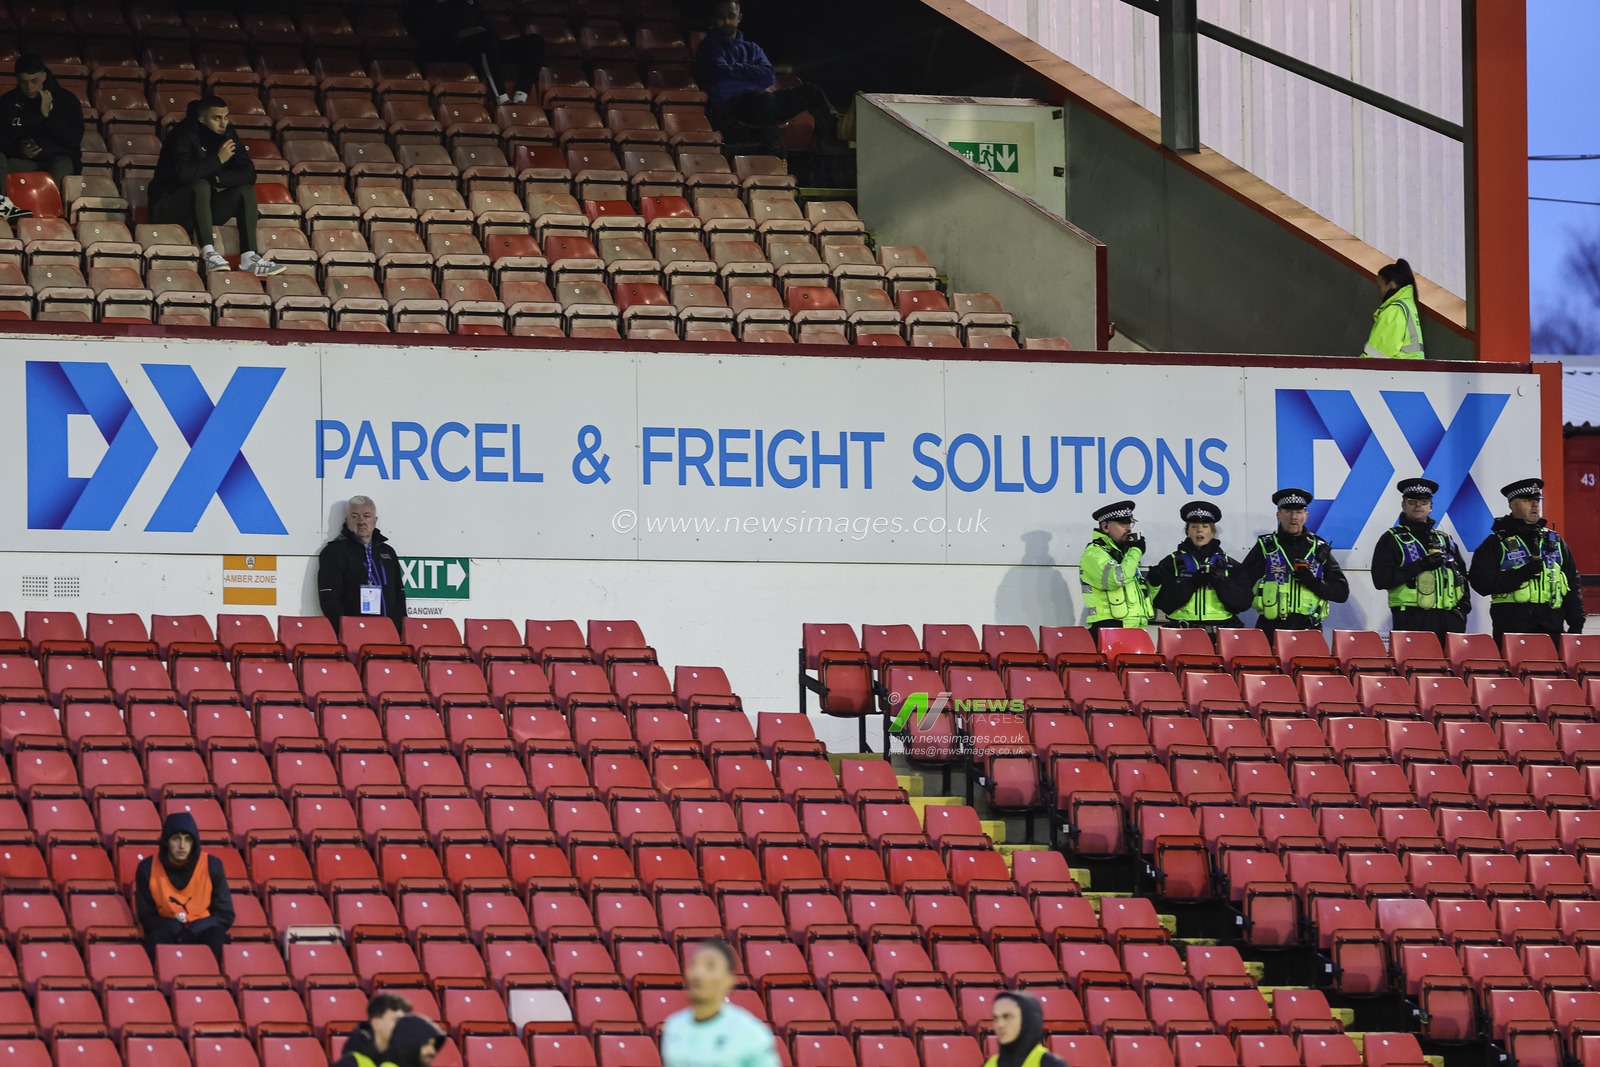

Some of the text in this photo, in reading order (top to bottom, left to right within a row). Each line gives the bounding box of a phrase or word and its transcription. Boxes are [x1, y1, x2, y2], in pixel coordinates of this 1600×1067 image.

[26, 361, 288, 535] DX
[316, 420, 1231, 496] PARCEL & FREIGHT SOLUTIONS
[1275, 389, 1511, 552] DX
[1580, 473, 1595, 487] 43
[225, 575, 276, 583] AMBER ZONE
[398, 560, 444, 589] XIT
[407, 607, 443, 615] GANGWAY
